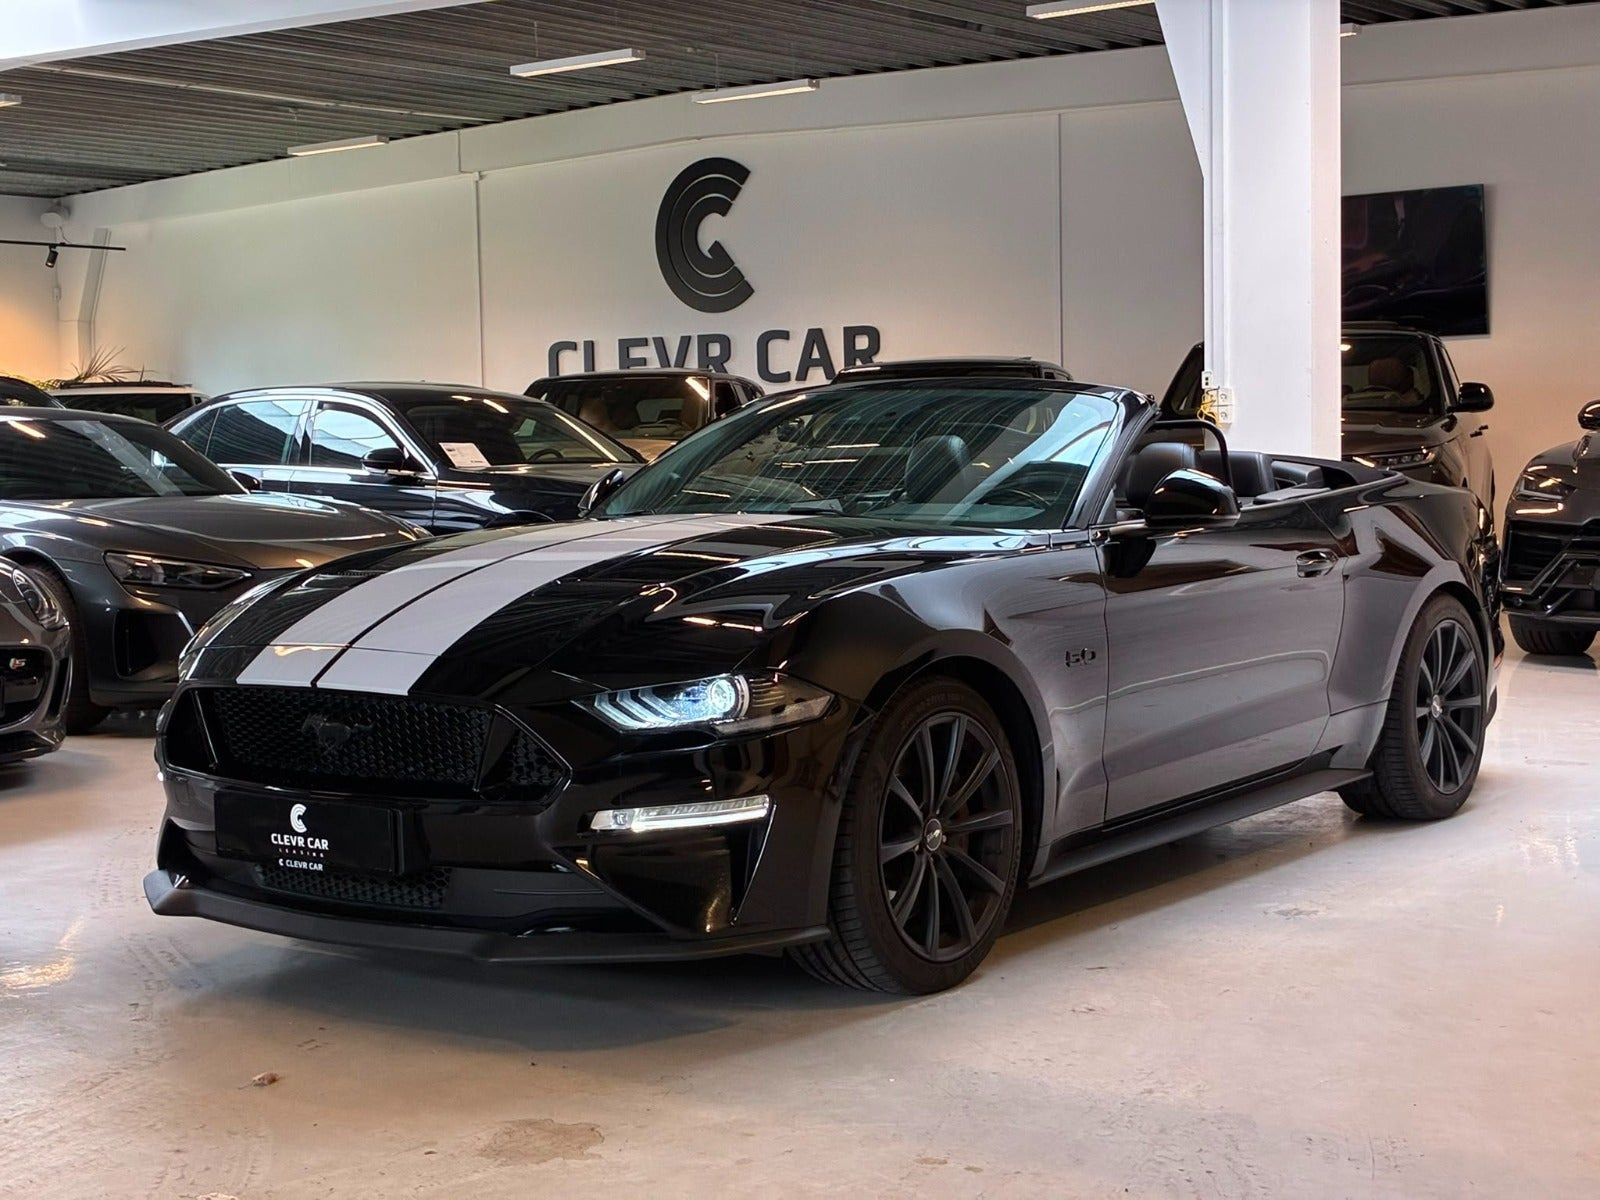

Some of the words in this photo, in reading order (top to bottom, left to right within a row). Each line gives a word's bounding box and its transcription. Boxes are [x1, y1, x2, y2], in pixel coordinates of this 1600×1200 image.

[757, 325, 880, 383] CAR
[271, 833, 305, 847] CLEVR
[307, 837, 329, 850] CAR
[285, 859, 308, 869] CLEVR
[308, 862, 323, 871] CAR
